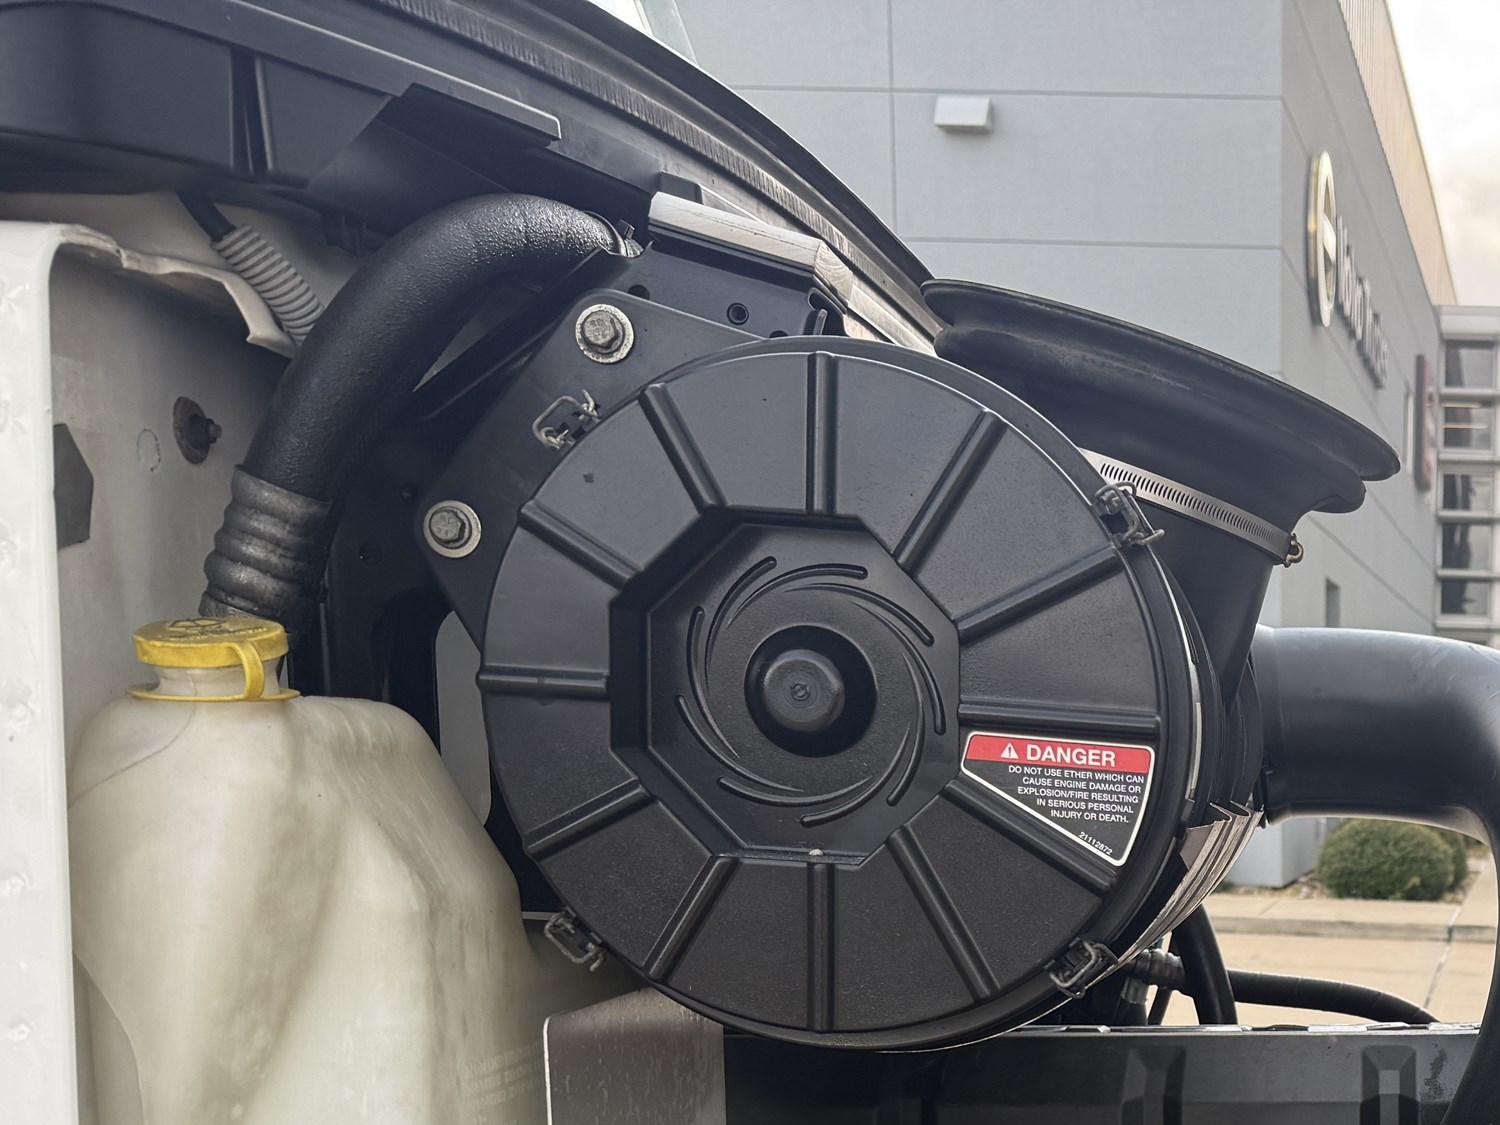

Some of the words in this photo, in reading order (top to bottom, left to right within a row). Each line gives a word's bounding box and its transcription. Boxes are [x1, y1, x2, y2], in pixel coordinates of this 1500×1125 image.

[1026, 743, 1116, 768] DANGER
[1008, 765, 1022, 773] DO
[1023, 766, 1042, 775] NOT
[1044, 768, 1062, 777] USE
[1064, 770, 1093, 779] ETHER
[1094, 772, 1124, 782] WHICH
[1125, 774, 1144, 783] CAN
[1022, 776, 1053, 786] CAUSE
[1054, 779, 1087, 789] ENGINE
[1089, 782, 1127, 792] DAMAGE
[1128, 785, 1142, 793] OR
[1017, 786, 1089, 800] EXPLOSION/FIRE
[1091, 792, 1139, 803] RESULTING
[1036, 798, 1046, 806] IN
[1047, 799, 1086, 810] SERIOUS
[1087, 802, 1134, 813] PERSONAL
[1050, 809, 1082, 819] INJURY
[1083, 812, 1097, 821] OR
[1098, 813, 1129, 823] DEATH.
[1079, 831, 1113, 855] 21112872
